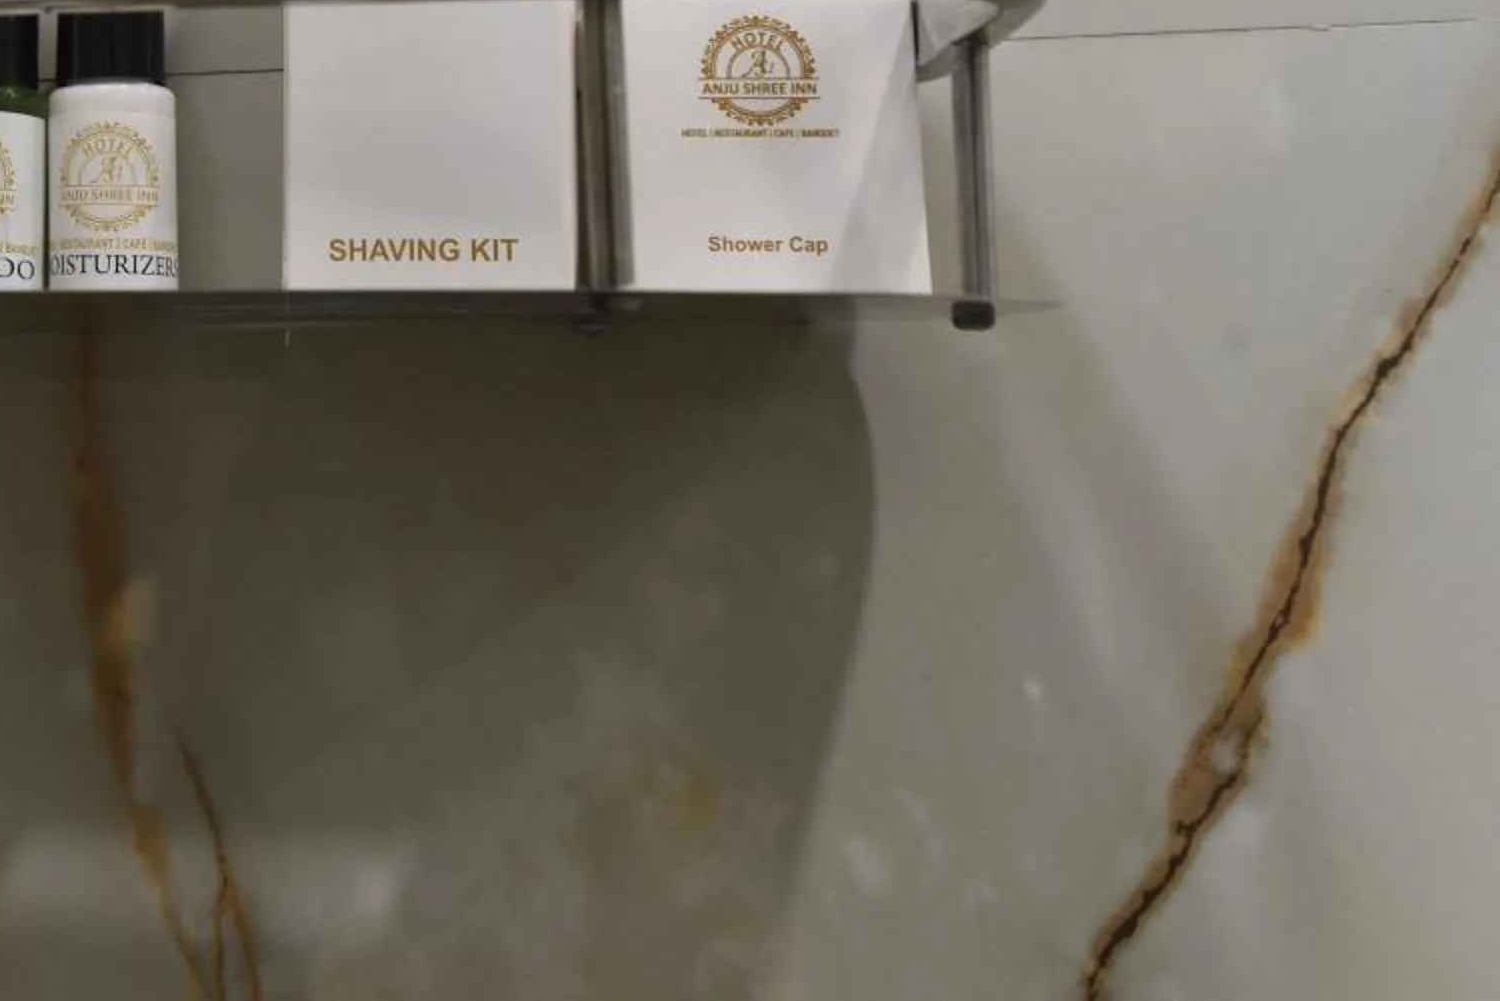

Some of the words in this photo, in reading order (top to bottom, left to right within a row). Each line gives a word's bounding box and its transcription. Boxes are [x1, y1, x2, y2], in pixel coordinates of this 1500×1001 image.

[730, 32, 784, 50] HOTEL
[703, 82, 739, 95] ANJU
[743, 82, 787, 95] SHREE
[792, 82, 817, 95] INN
[136, 189, 159, 202] INN
[329, 238, 461, 262] SHAVING
[470, 238, 518, 261] KIT
[708, 235, 783, 252] Shower
[789, 235, 829, 256] Cap
[51, 254, 178, 278] OISTURIZER
